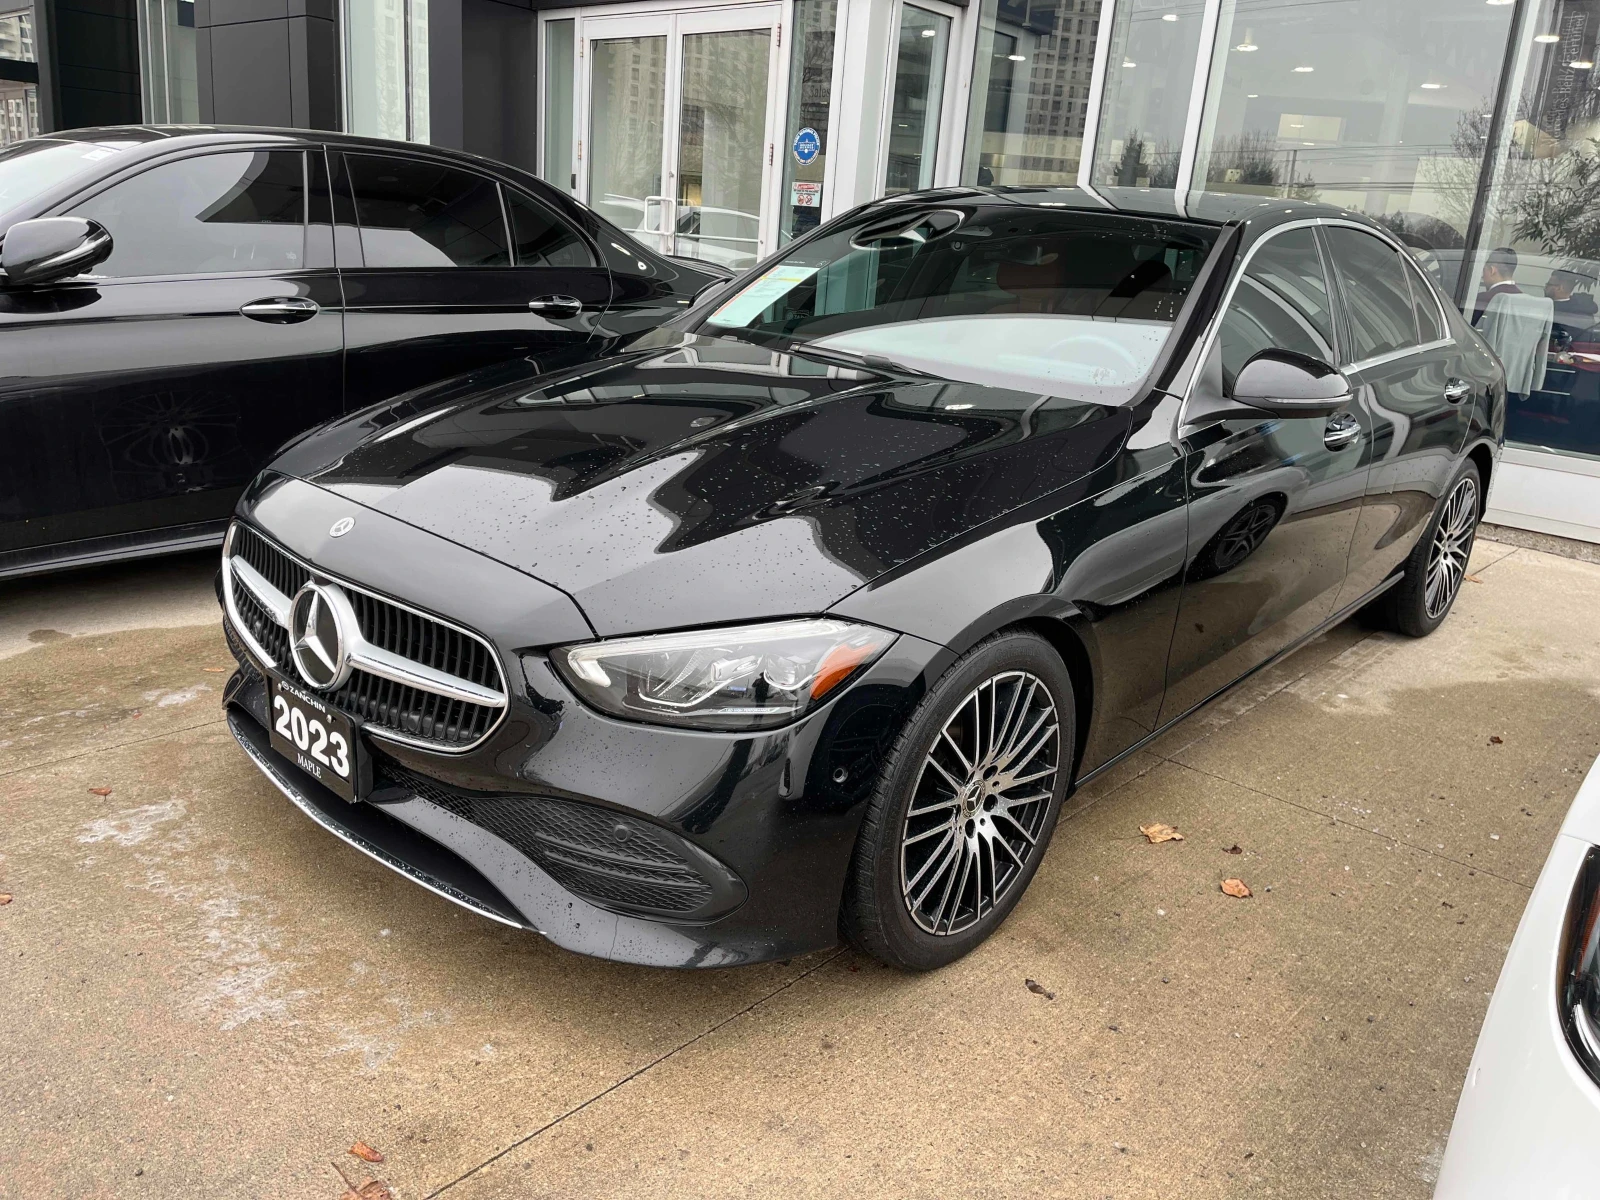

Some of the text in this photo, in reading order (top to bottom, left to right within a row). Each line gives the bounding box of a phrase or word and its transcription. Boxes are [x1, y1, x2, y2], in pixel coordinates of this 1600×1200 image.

[810, 84, 831, 98] Sales
[289, 686, 326, 713] ZANCHIN
[274, 695, 350, 777] 2023
[297, 753, 322, 779] MAPLE
